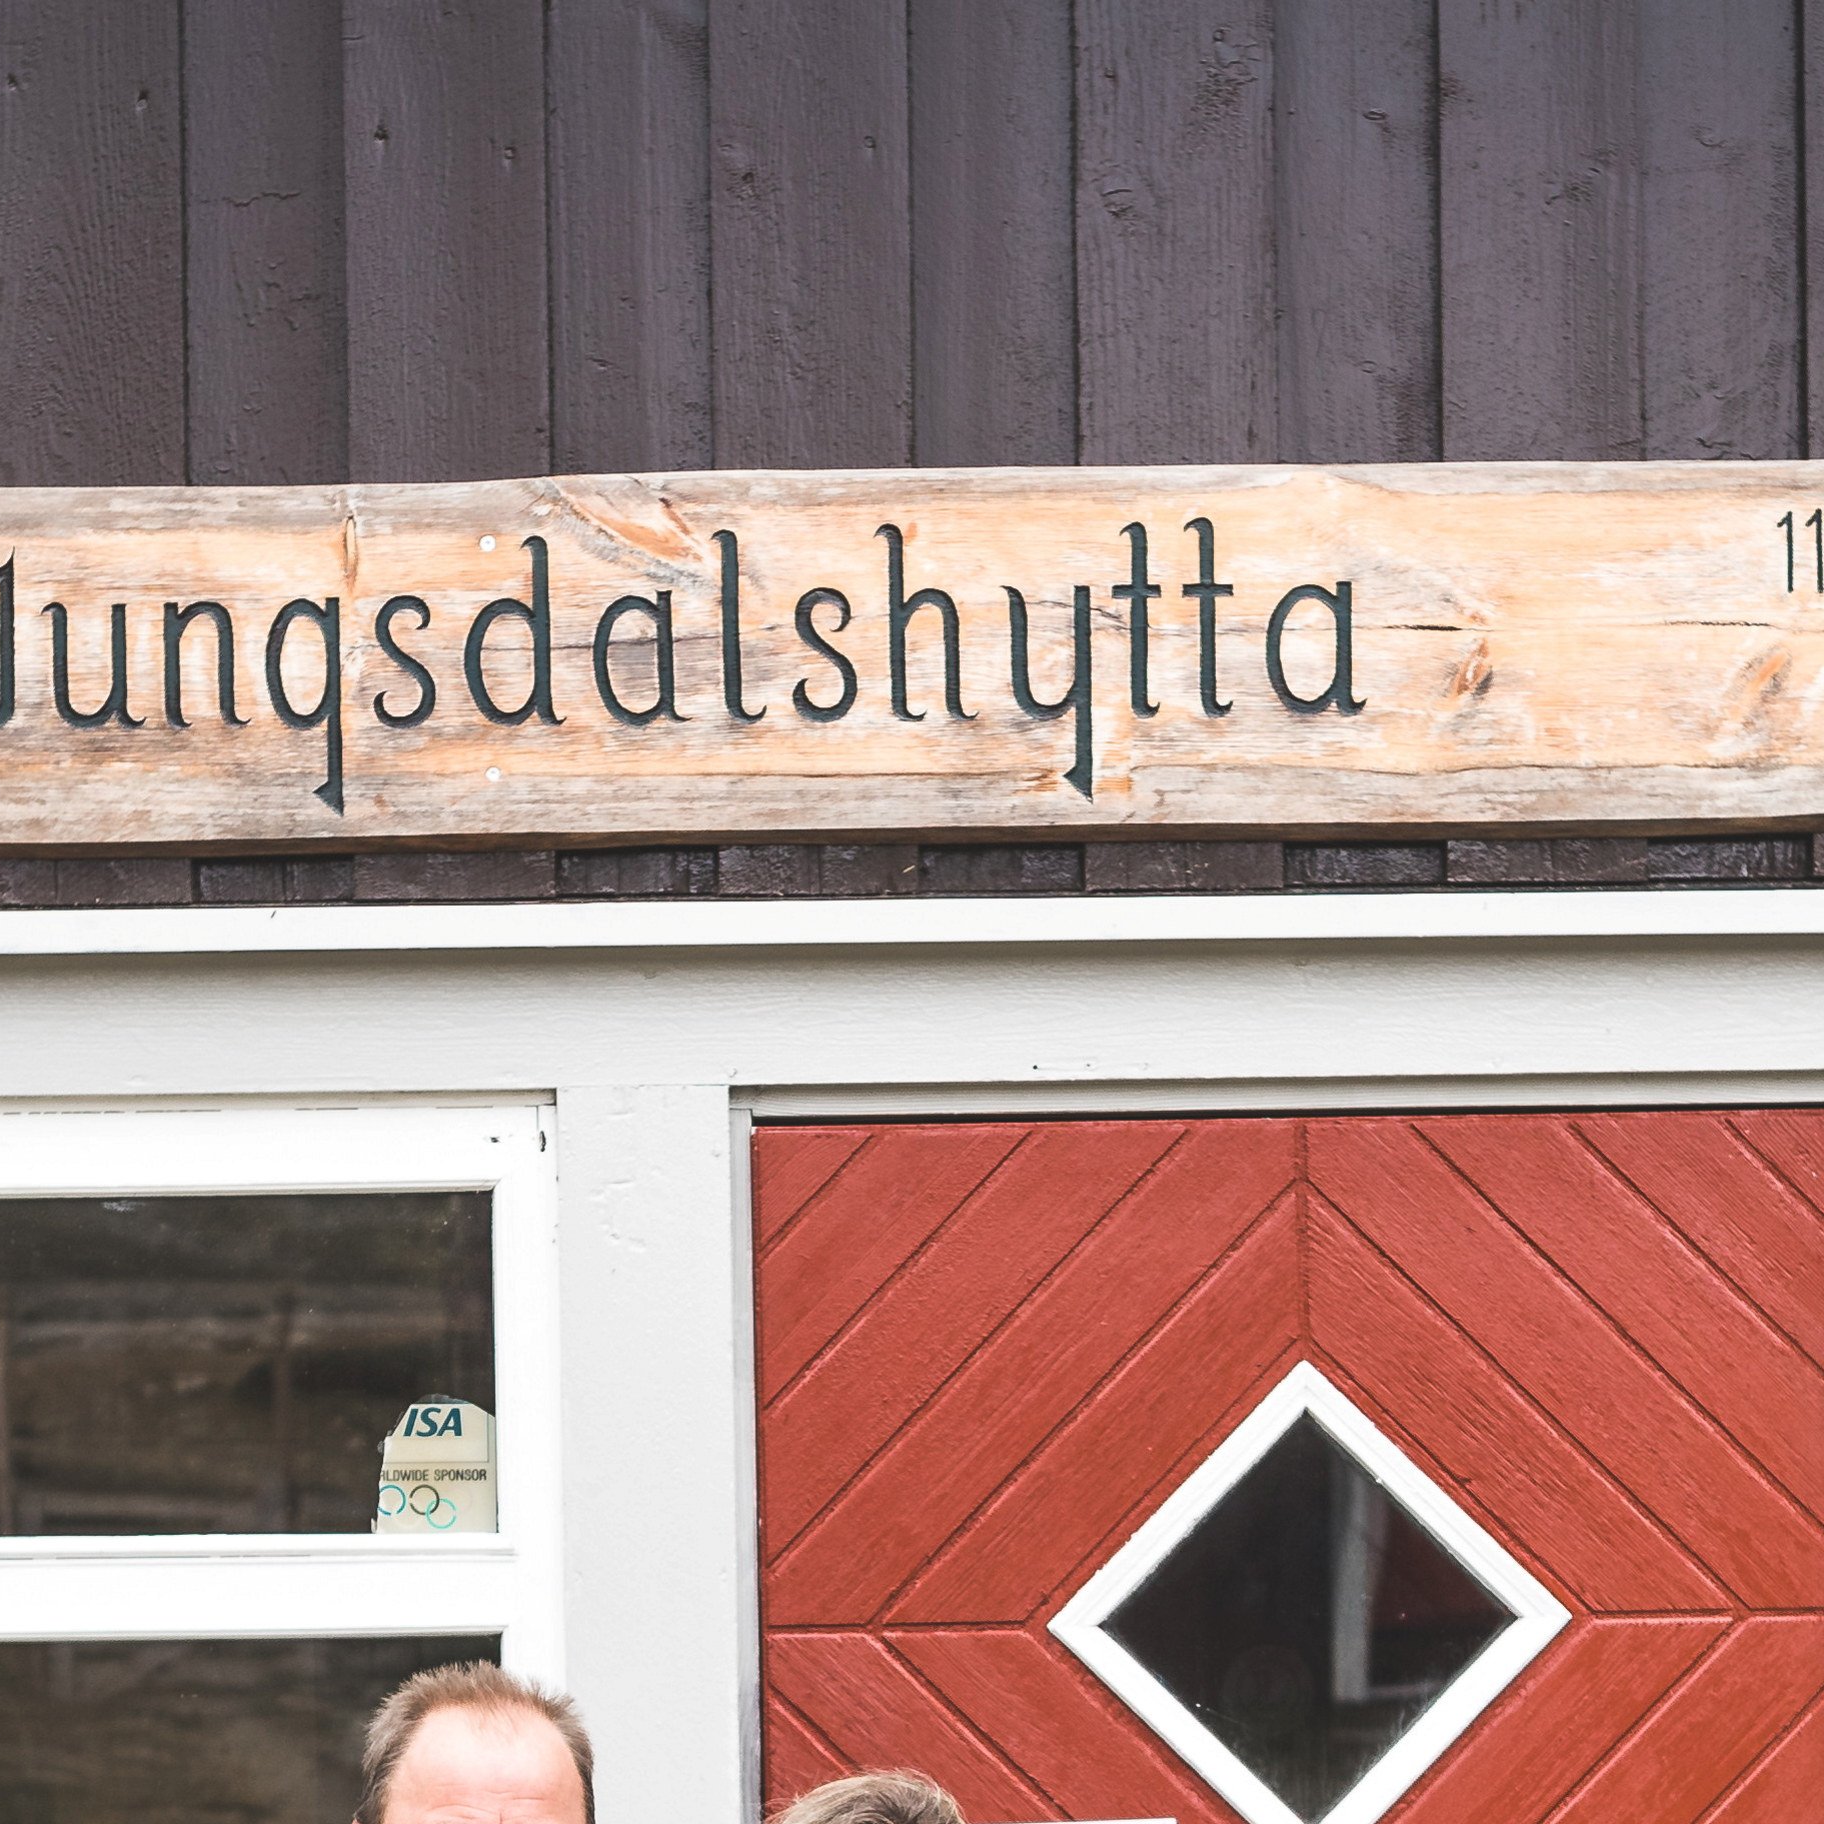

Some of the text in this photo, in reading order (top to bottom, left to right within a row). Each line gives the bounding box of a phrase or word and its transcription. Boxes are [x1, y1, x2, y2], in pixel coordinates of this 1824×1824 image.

[402, 1406, 463, 1438] ISA
[379, 1468, 488, 1482] RLDWIDE SPONSOR
